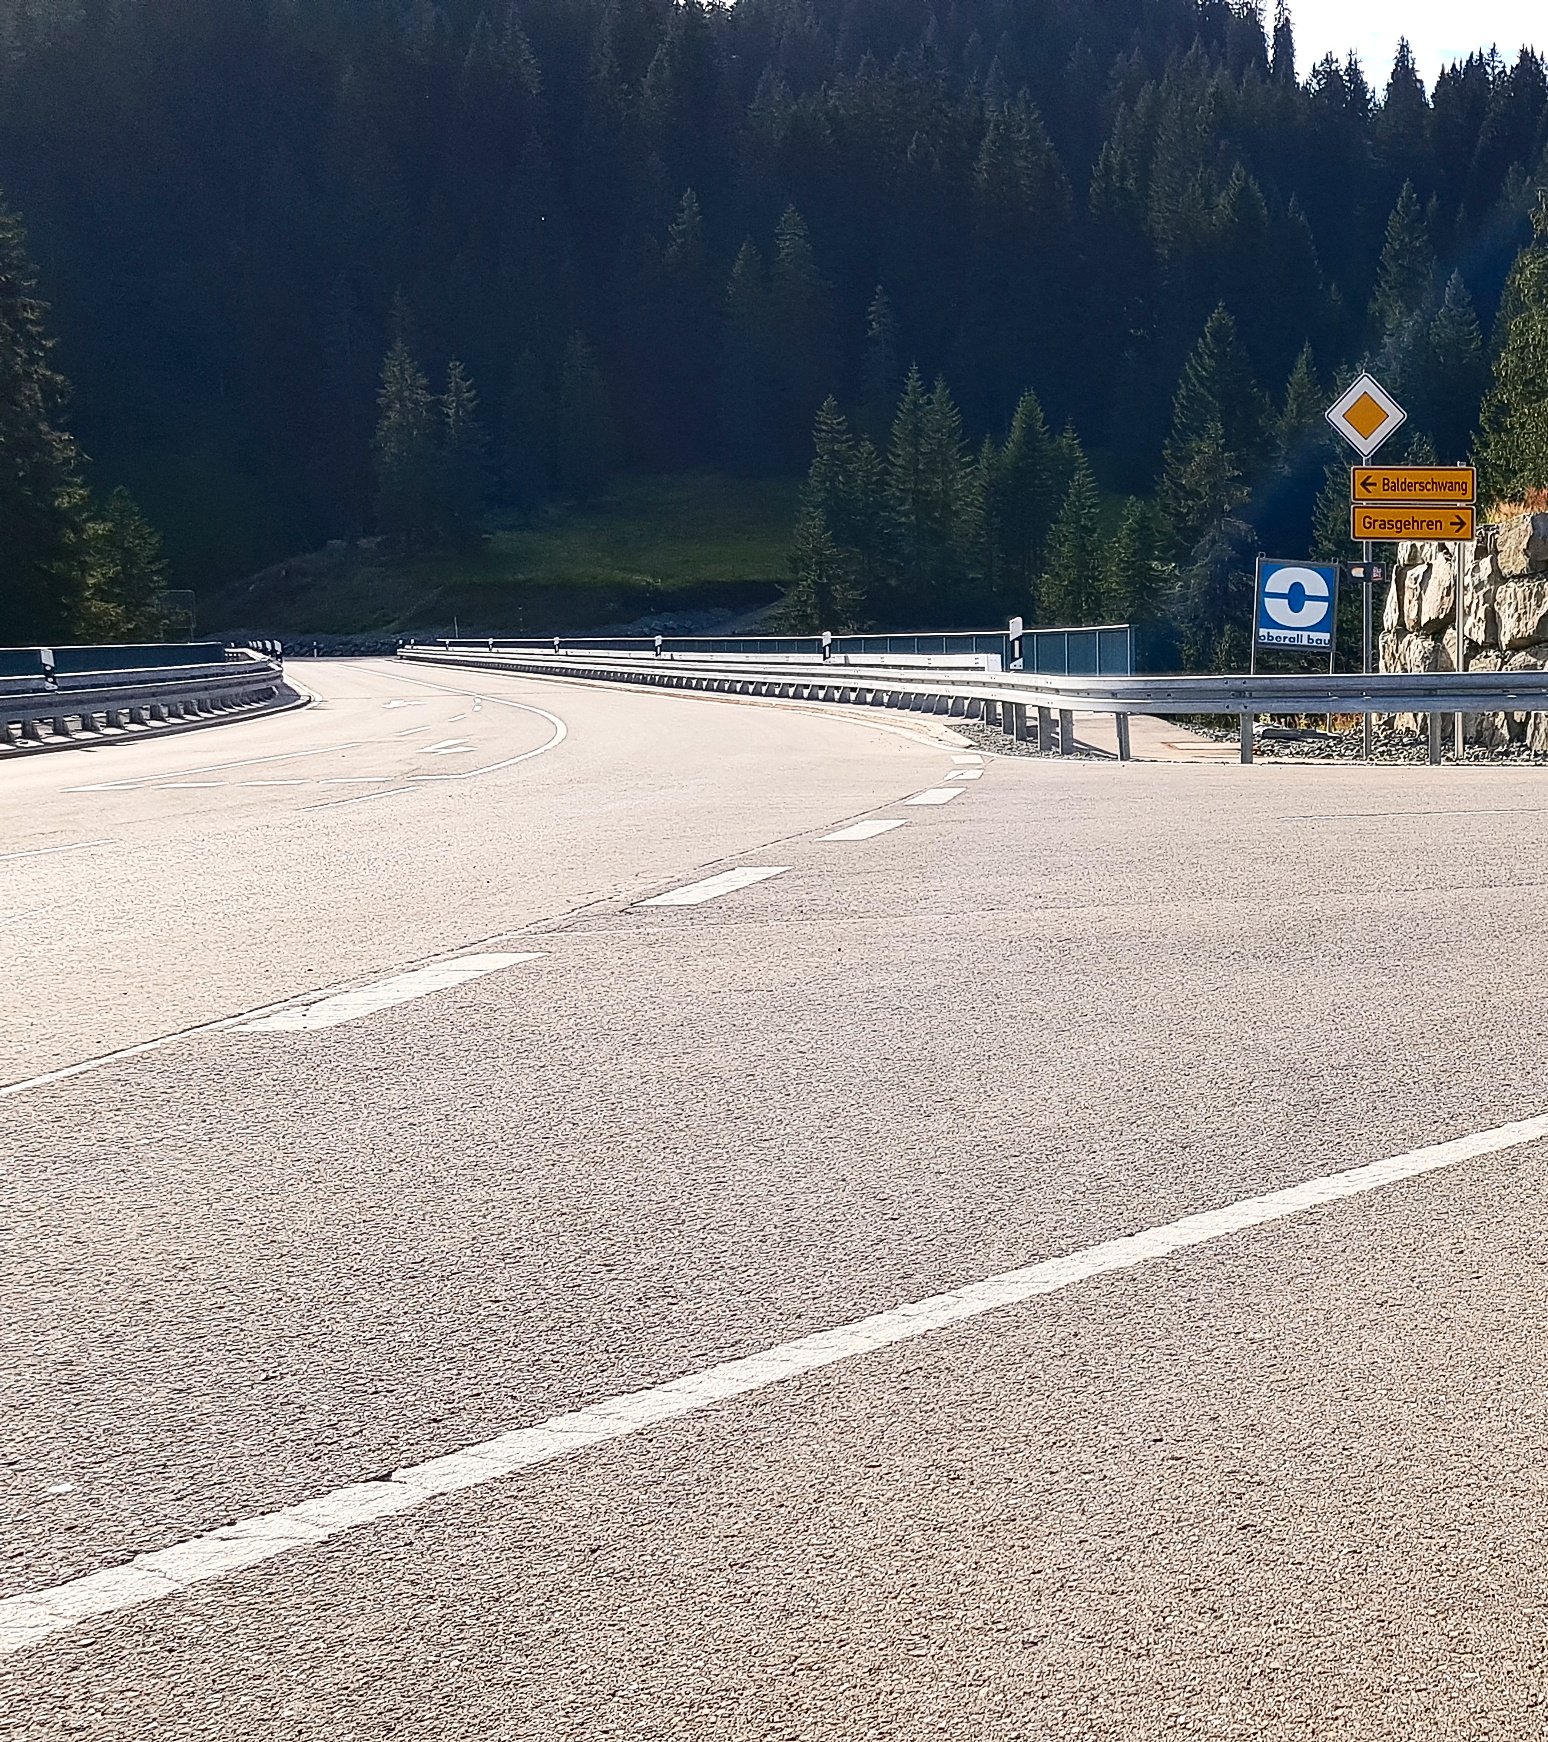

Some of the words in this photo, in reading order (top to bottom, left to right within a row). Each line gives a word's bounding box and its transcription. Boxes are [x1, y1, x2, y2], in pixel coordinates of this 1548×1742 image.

[1382, 478, 1467, 496] Balderschwang
[1362, 516, 1443, 533] Grasgehren
[1259, 632, 1303, 644] oberall
[1307, 634, 1331, 645] bau
